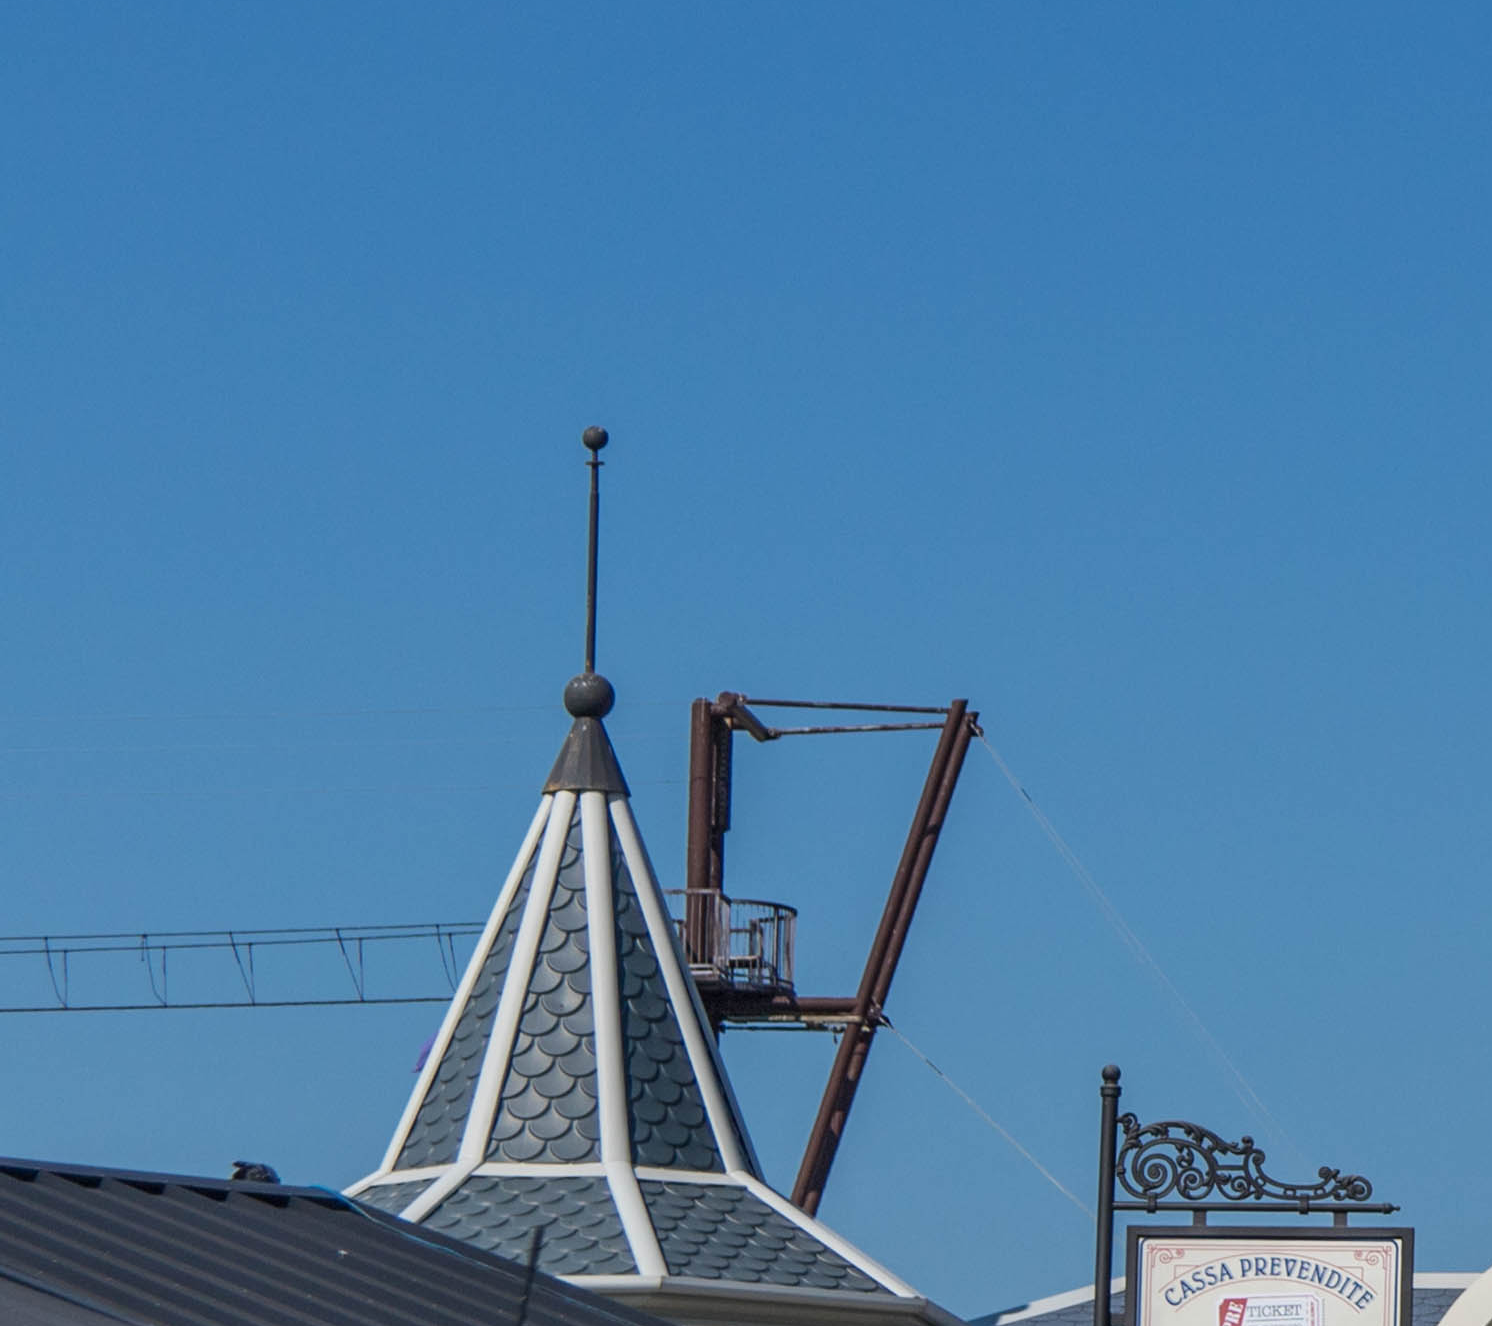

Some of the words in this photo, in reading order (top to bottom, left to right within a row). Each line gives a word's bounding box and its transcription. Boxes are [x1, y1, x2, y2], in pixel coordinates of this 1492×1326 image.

[1164, 1263, 1234, 1306] CASSA
[1239, 1256, 1376, 1311] PREVENDITE
[1246, 1304, 1302, 1318] TICKET
